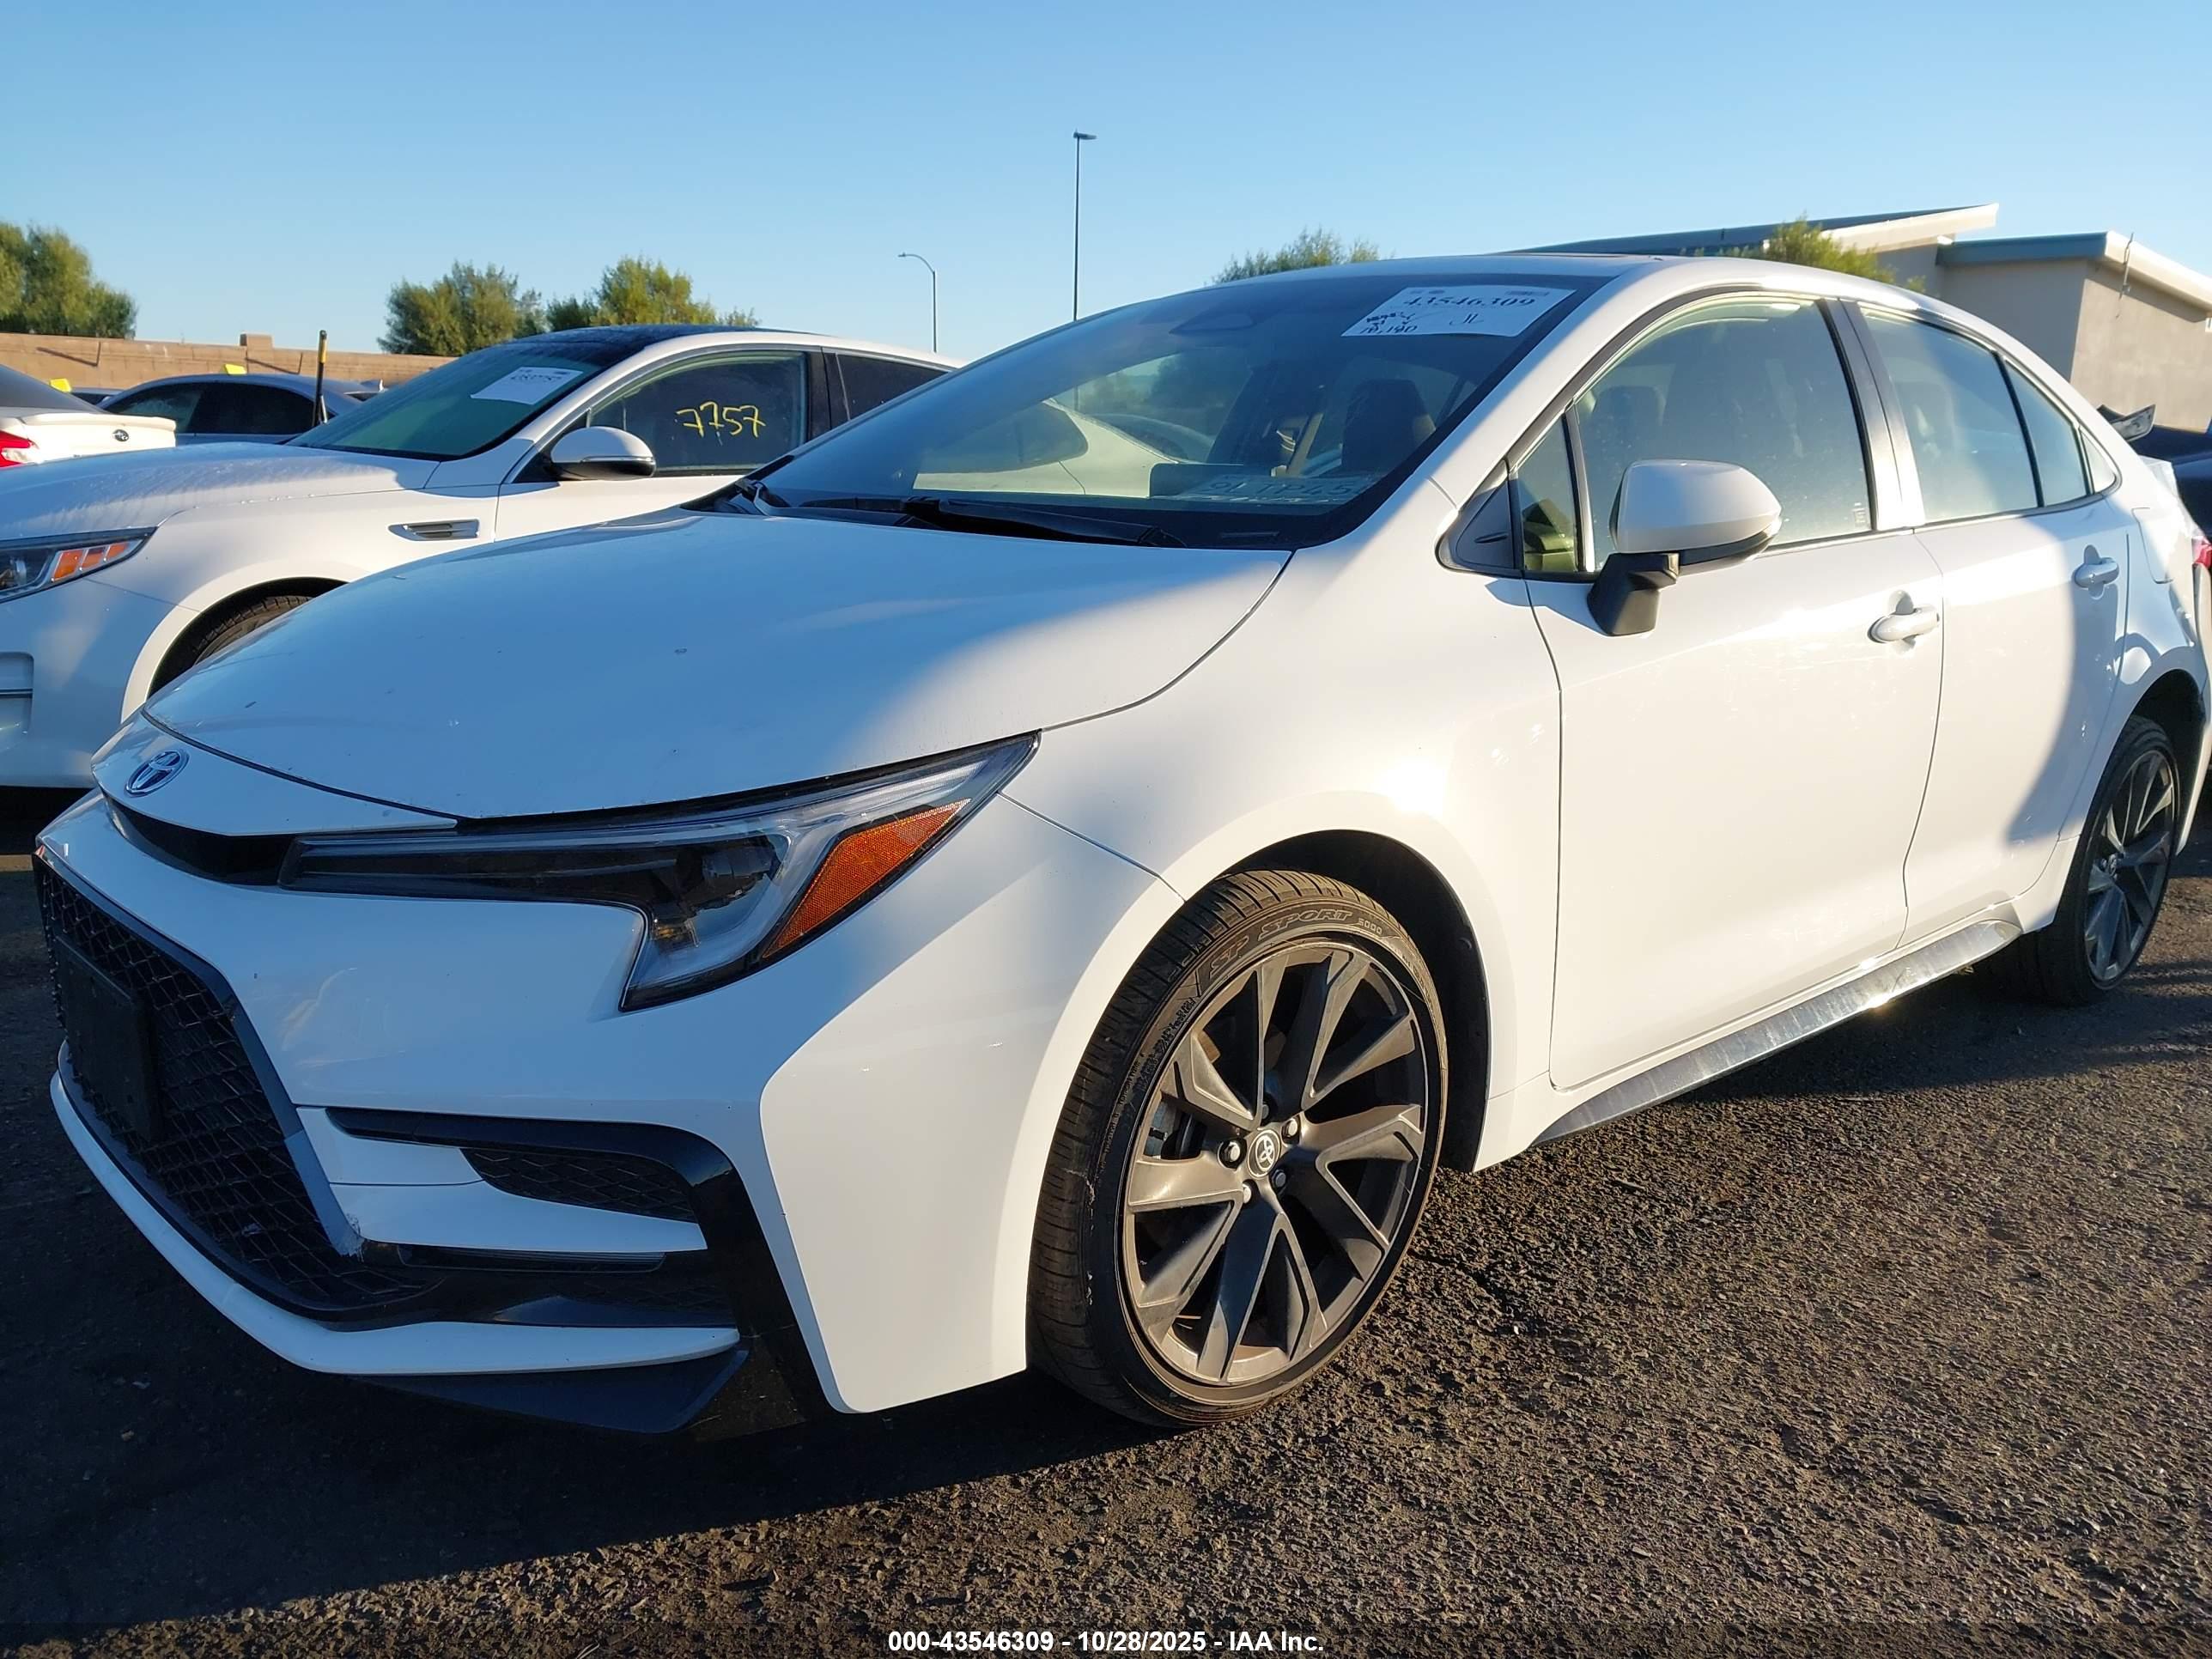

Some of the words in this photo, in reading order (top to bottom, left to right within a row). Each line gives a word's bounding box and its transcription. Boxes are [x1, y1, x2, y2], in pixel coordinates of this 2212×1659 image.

[676, 400, 766, 438] 7757
[1209, 935, 1249, 980] SP
[1257, 908, 1353, 941] SPORT
